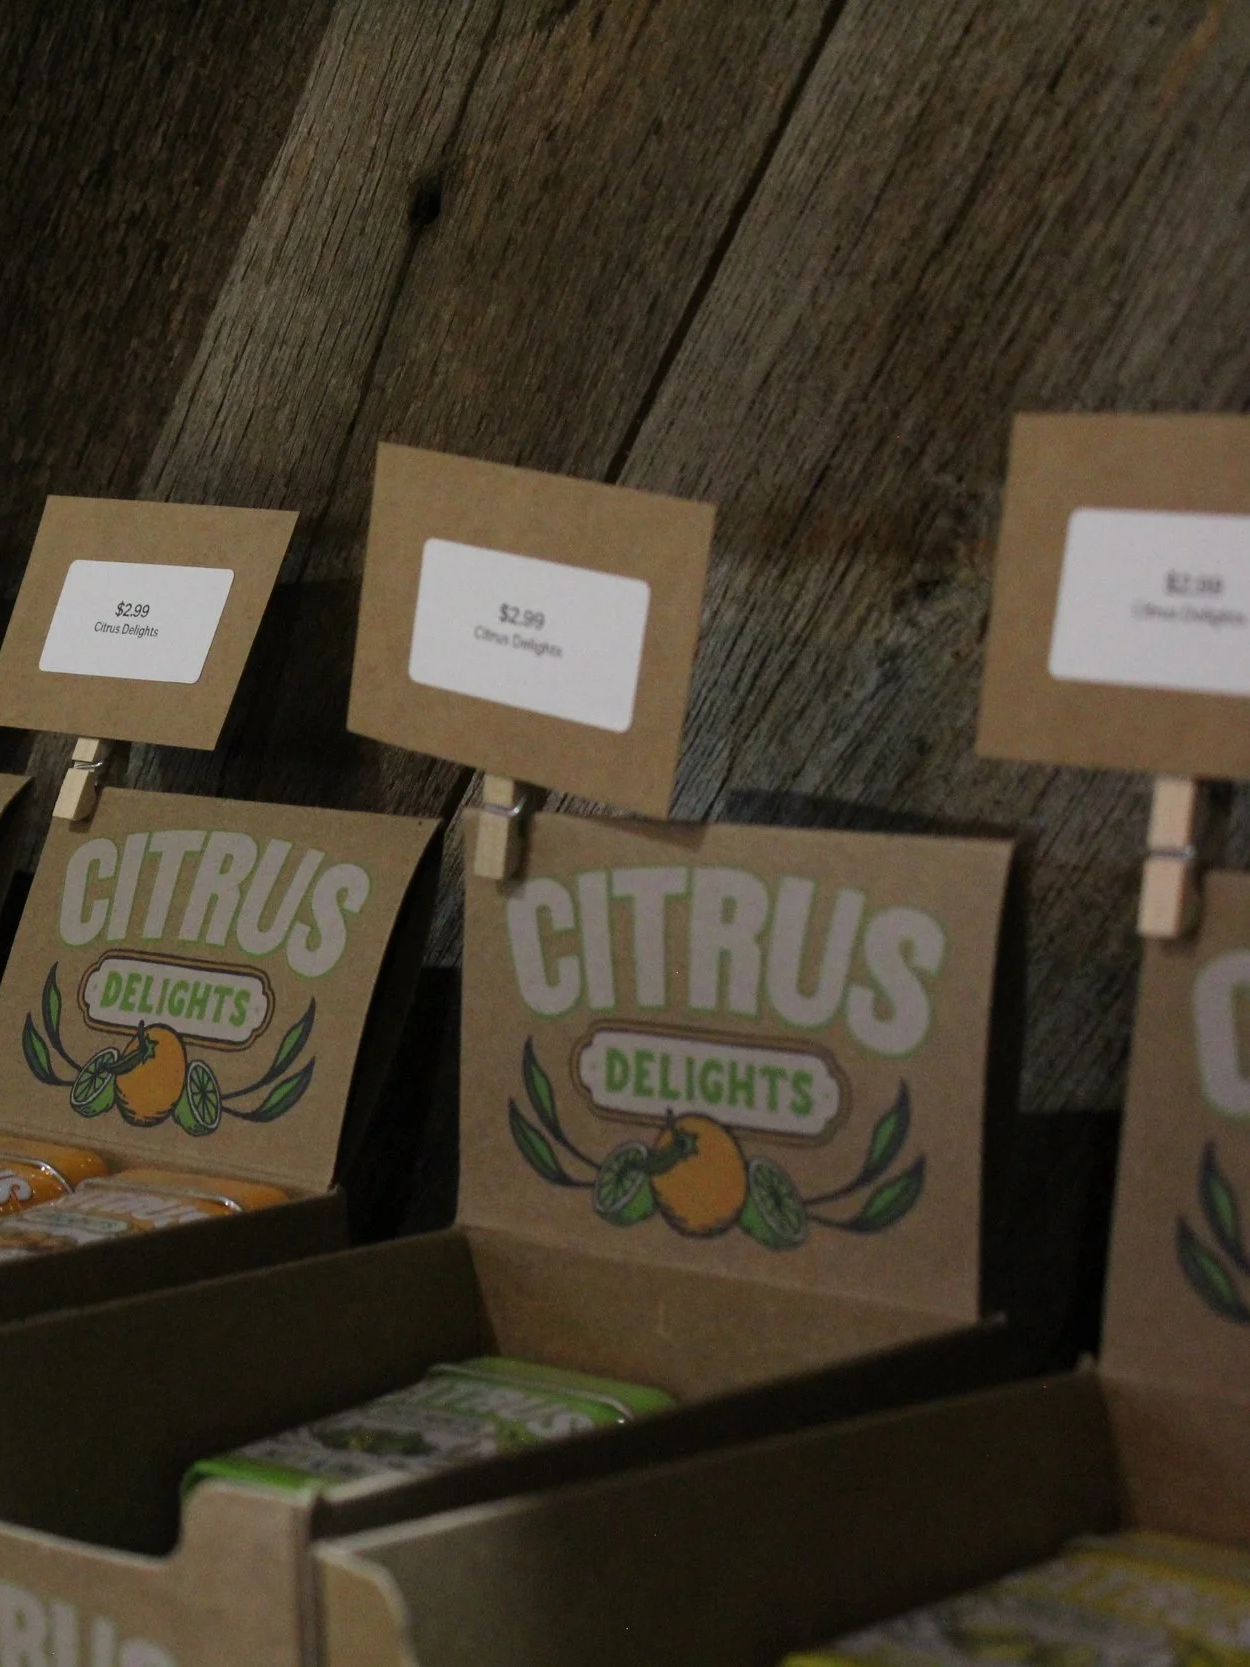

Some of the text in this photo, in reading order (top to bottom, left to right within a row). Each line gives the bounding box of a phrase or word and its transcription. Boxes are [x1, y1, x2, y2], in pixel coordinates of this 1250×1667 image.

[94, 621, 159, 639] Citrus Delights
[114, 600, 151, 618] $2.99
[498, 602, 546, 631] $2.99
[473, 621, 562, 657] Citrus Delights
[58, 829, 371, 980] CITRUS
[505, 866, 945, 1059] CITRUS
[100, 969, 251, 1028] DELIGHTS
[603, 1046, 815, 1114] DELIGHTS
